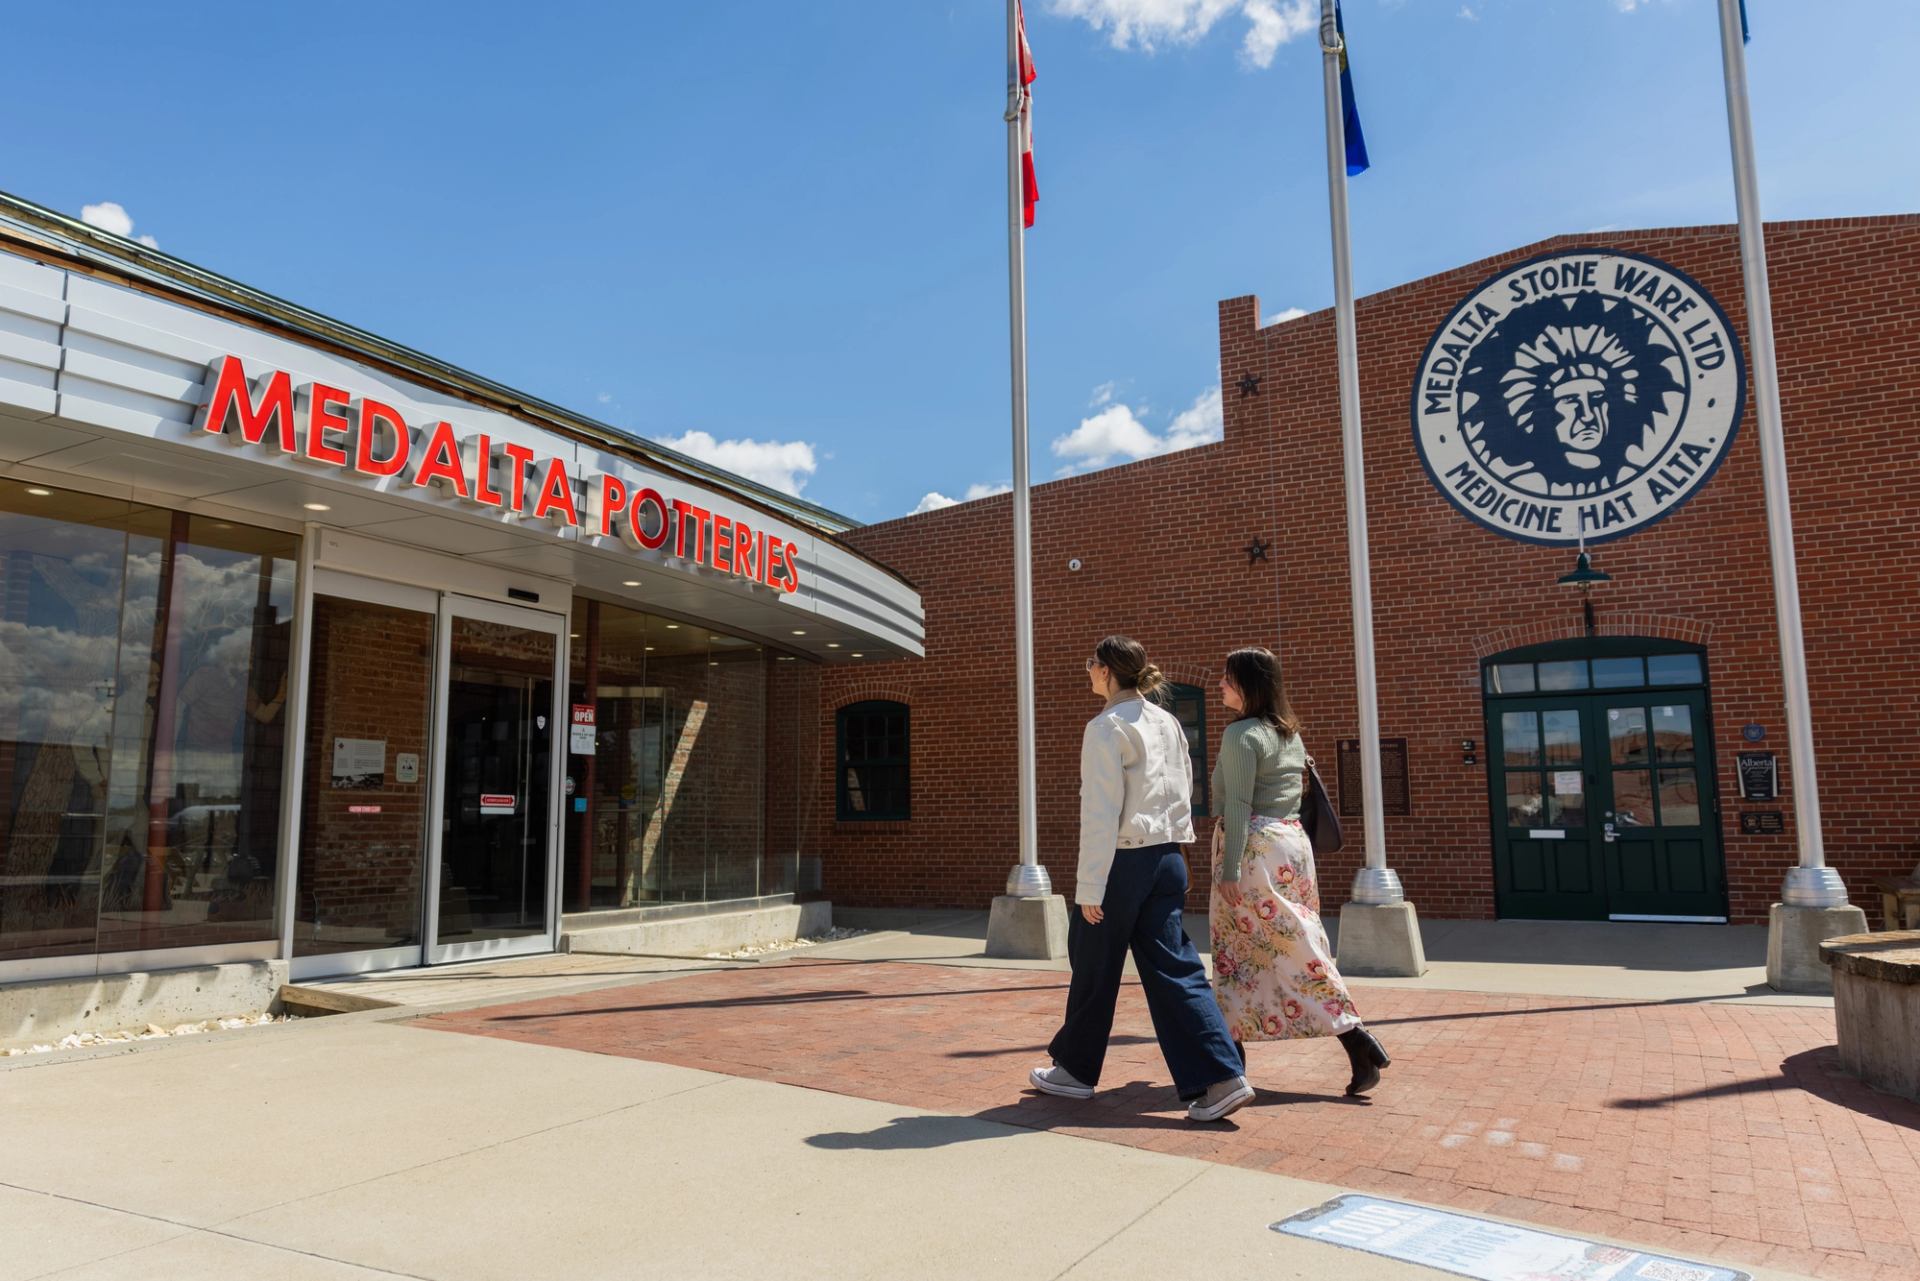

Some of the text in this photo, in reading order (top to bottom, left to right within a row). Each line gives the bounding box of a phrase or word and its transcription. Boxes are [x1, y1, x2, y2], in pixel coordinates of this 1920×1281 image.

[1424, 260, 1727, 416] MEDALTA STONE WARE LTD.
[203, 354, 800, 595] MEDALTA POTTERIES
[1444, 436, 1717, 533] MEDICINE HAT ALTA.
[574, 711, 595, 723] OPEN
[1310, 1204, 1419, 1242] TOUR
